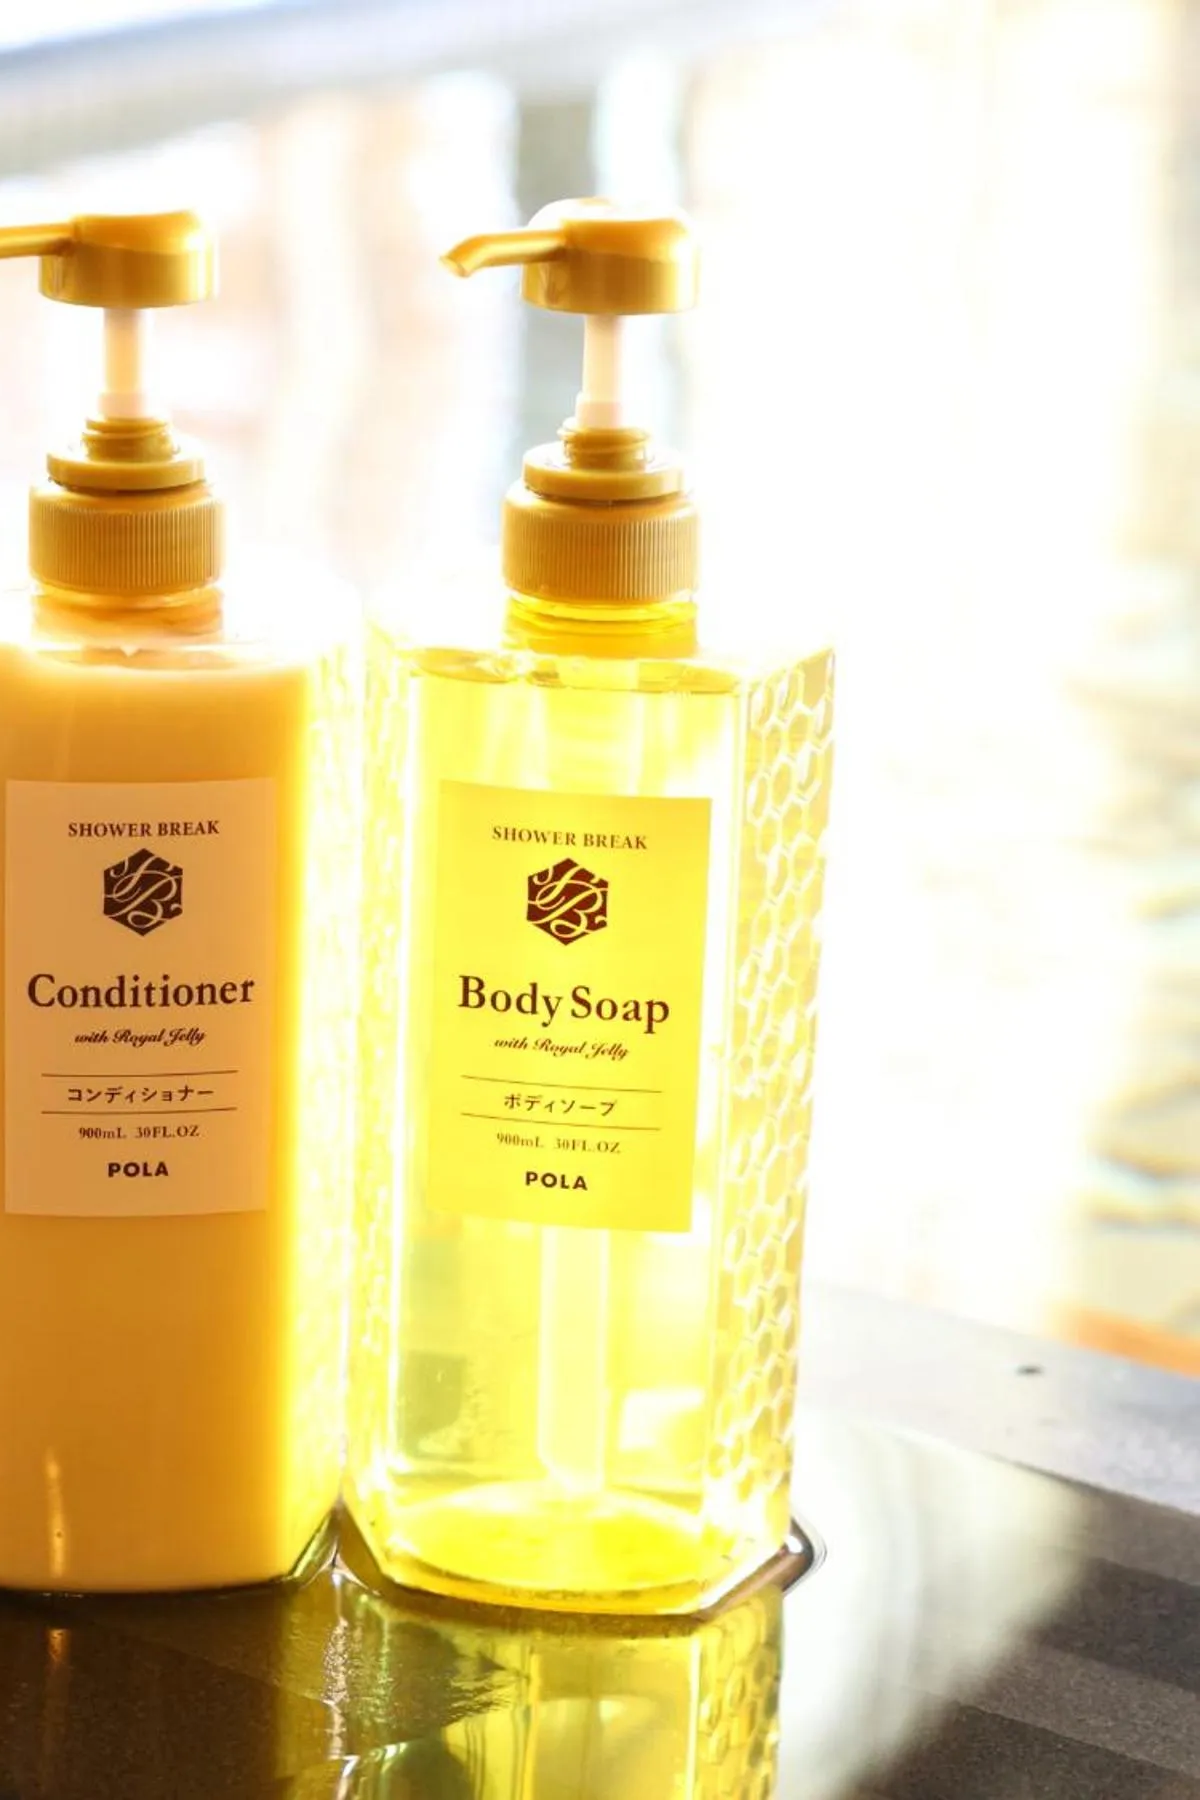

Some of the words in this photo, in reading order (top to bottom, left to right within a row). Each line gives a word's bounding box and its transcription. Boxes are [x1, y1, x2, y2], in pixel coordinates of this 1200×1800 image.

[68, 822, 152, 838] SHOWER
[157, 820, 220, 837] BREAK
[492, 826, 576, 846] SHOWER
[583, 833, 648, 850] BREAK
[27, 973, 255, 1009] Conditioner
[457, 975, 563, 1028] Body
[570, 985, 670, 1035] Soap
[74, 1029, 109, 1044] with
[111, 1028, 163, 1047] Royal
[162, 1027, 206, 1047] Jelly
[494, 1036, 529, 1050] with
[532, 1038, 584, 1058] Royal
[584, 1041, 629, 1061] Jelly
[67, 1084, 214, 1104] コンディショナー
[503, 1093, 617, 1117] ボディソープ
[78, 1126, 127, 1140] 900mL
[496, 1132, 543, 1149] 900mL
[107, 1161, 169, 1178] POLA
[525, 1170, 588, 1191] POLA
